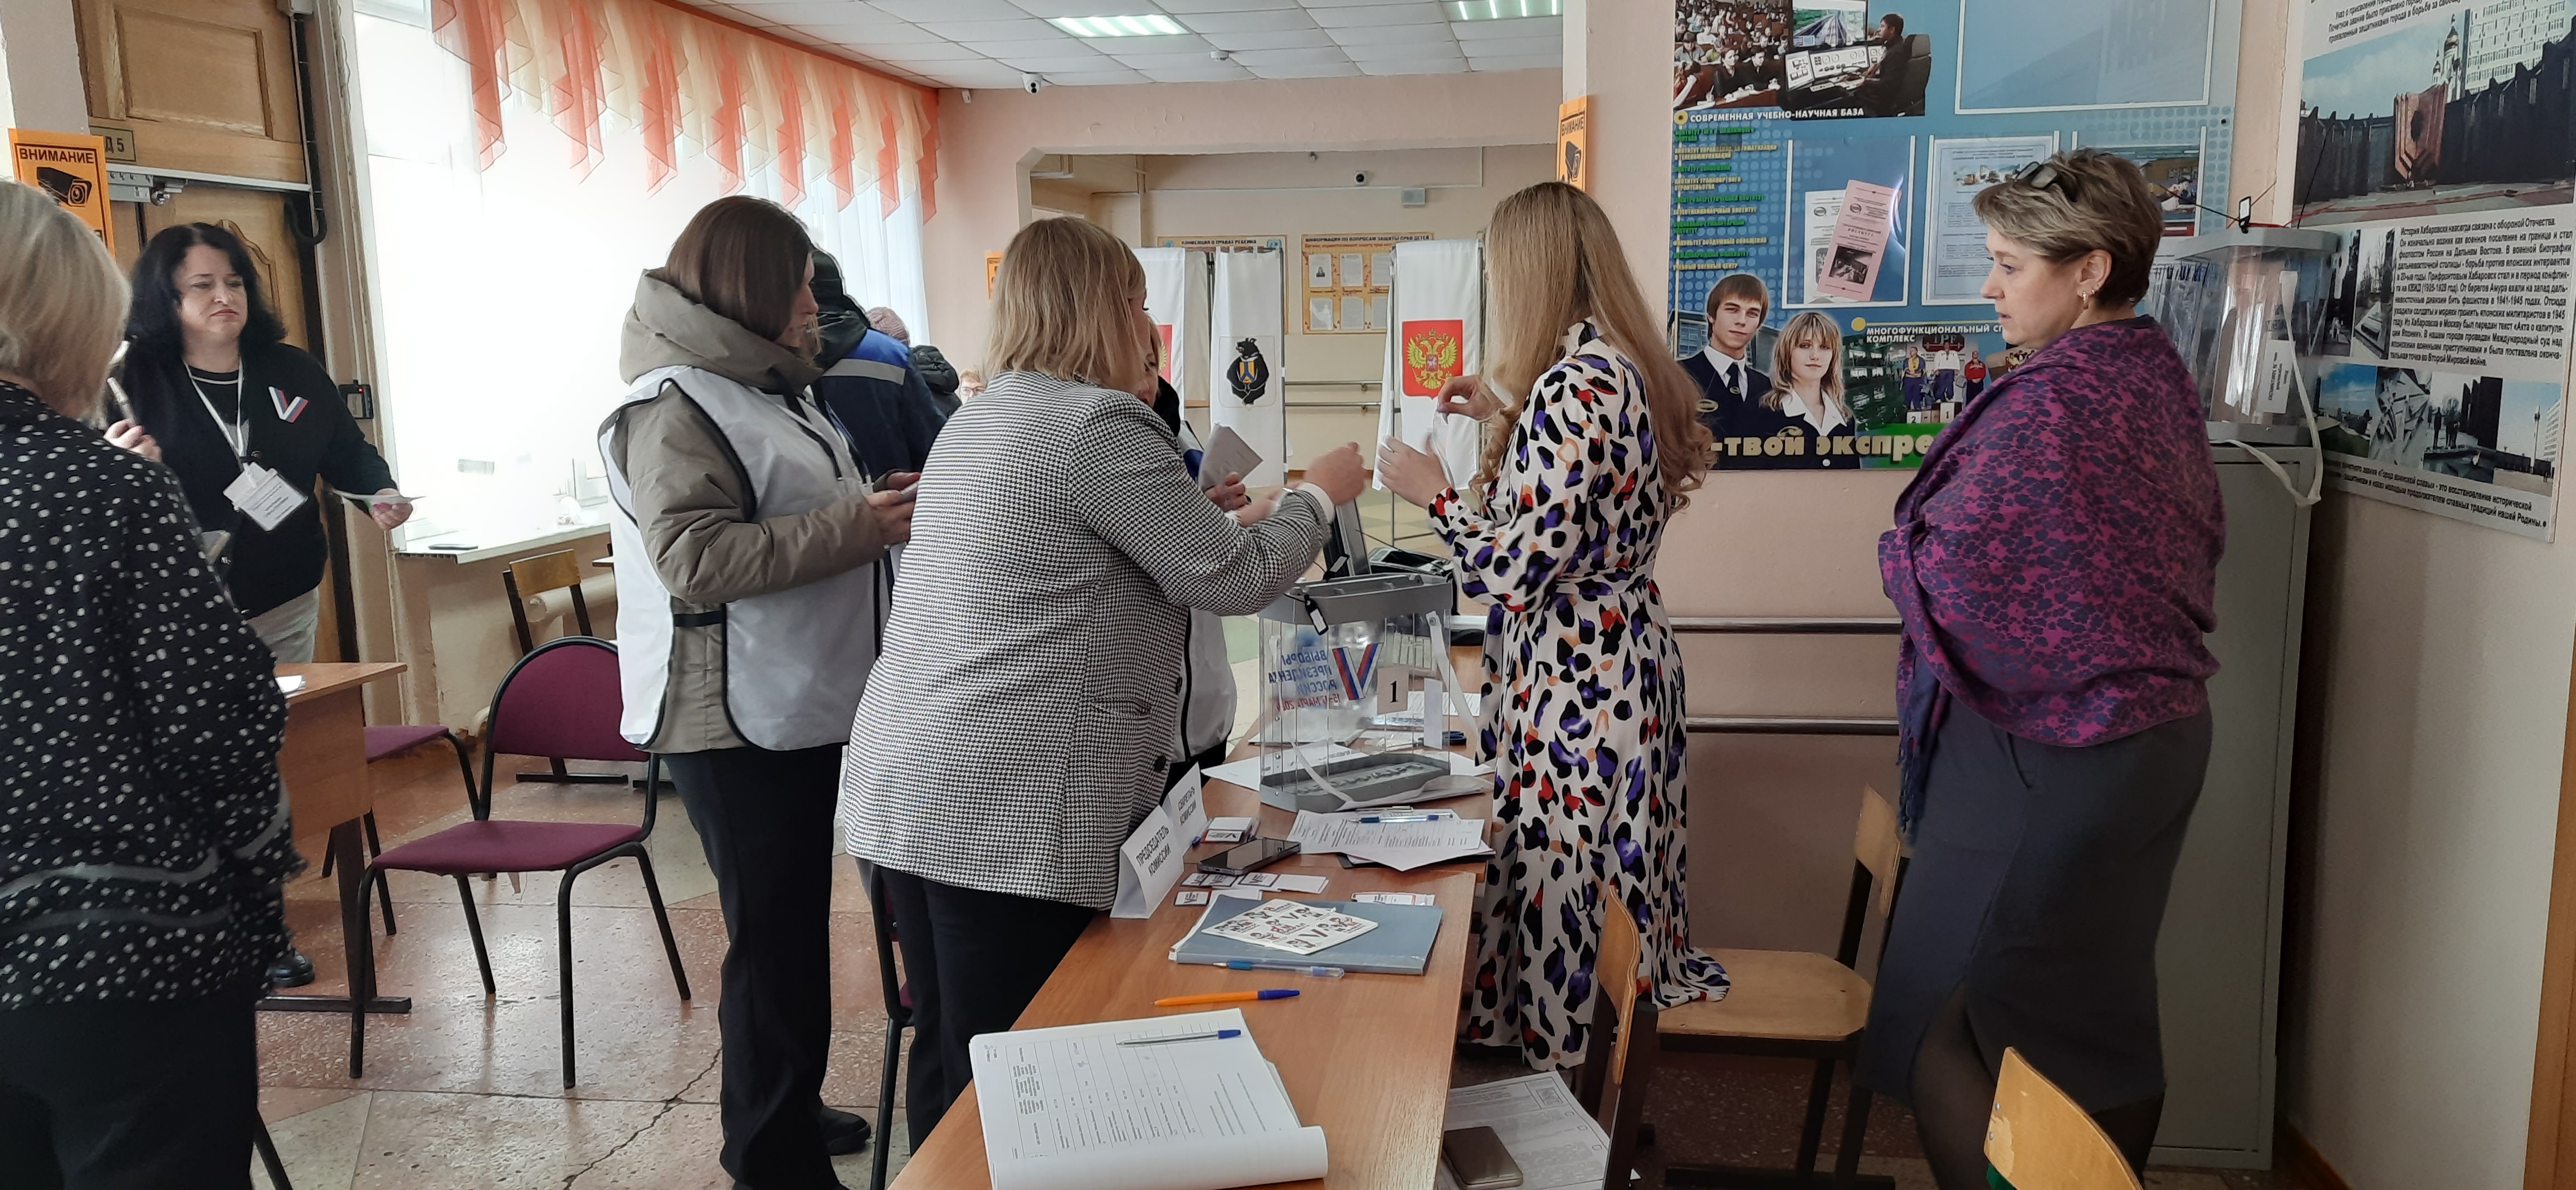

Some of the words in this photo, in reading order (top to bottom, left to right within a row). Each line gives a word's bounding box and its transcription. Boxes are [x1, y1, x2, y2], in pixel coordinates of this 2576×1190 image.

[1690, 111, 1754, 122] СОВРЕМЕННАЯ
[1757, 110, 1837, 120] УЧЕБНО-НАУЧНАЯ
[1840, 108, 1864, 117] БАЗА
[1562, 117, 1584, 136] ВНИМАНИЕ
[117, 138, 125, 152] 5
[19, 148, 94, 164] ВНИМАНИЕ
[2497, 220, 2524, 229] обороной
[1867, 324, 1989, 335] МНОГОФУНКЦИОНАЛЬНЫЙ
[1817, 436, 1935, 461] экспре
[2492, 497, 2532, 511] исторической
[2497, 511, 2515, 520] нашей
[2516, 514, 2541, 526] Родины.
[1390, 680, 1397, 703] 1
[1178, 786, 1195, 811] СЕКРЕТАРЬ
[1180, 799, 1196, 826] КОМИССИИ
[1136, 825, 1169, 867] ПРЕДСЕДАТЕЛЬ
[1148, 843, 1171, 877] КОМИССИИ
